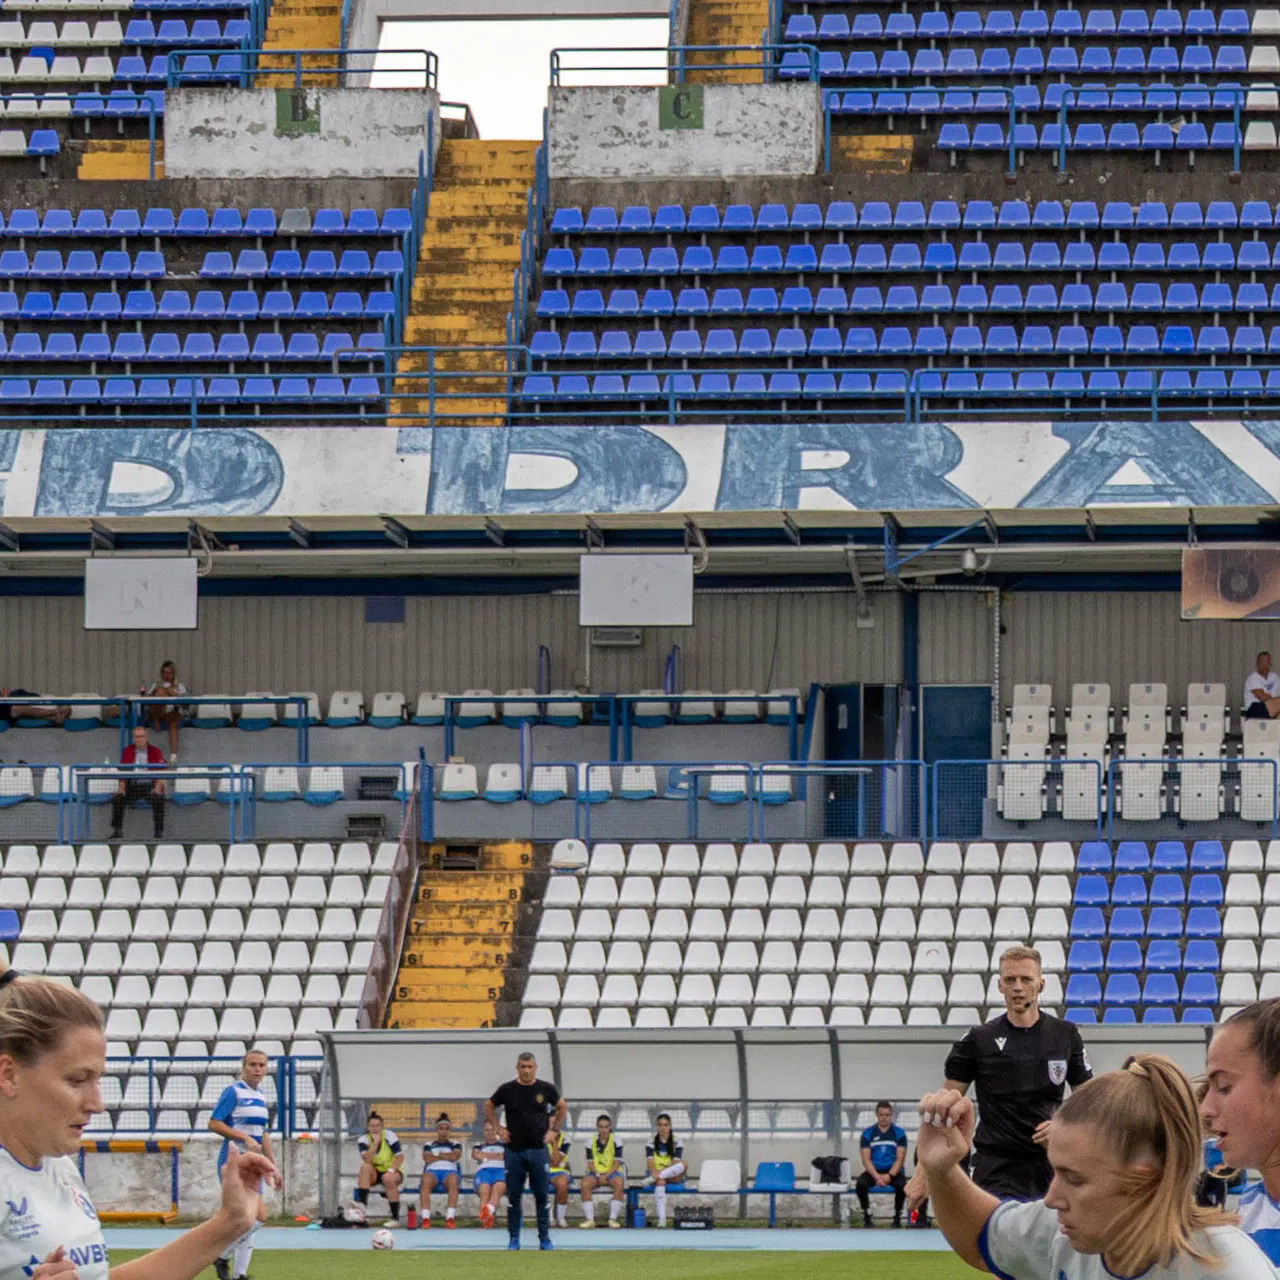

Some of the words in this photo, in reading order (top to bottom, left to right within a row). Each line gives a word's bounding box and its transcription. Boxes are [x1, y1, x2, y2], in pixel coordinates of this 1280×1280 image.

[433, 854, 441, 864] 9
[520, 854, 529, 864] 9
[422, 888, 431, 900] 8
[509, 888, 518, 900] 8
[414, 921, 422, 933] 7
[500, 921, 509, 932] 7
[408, 954, 416, 965] 6
[496, 954, 504, 965] 6
[399, 987, 408, 998] 5
[488, 988, 496, 999] 5
[63, 1244, 109, 1267] AVB
